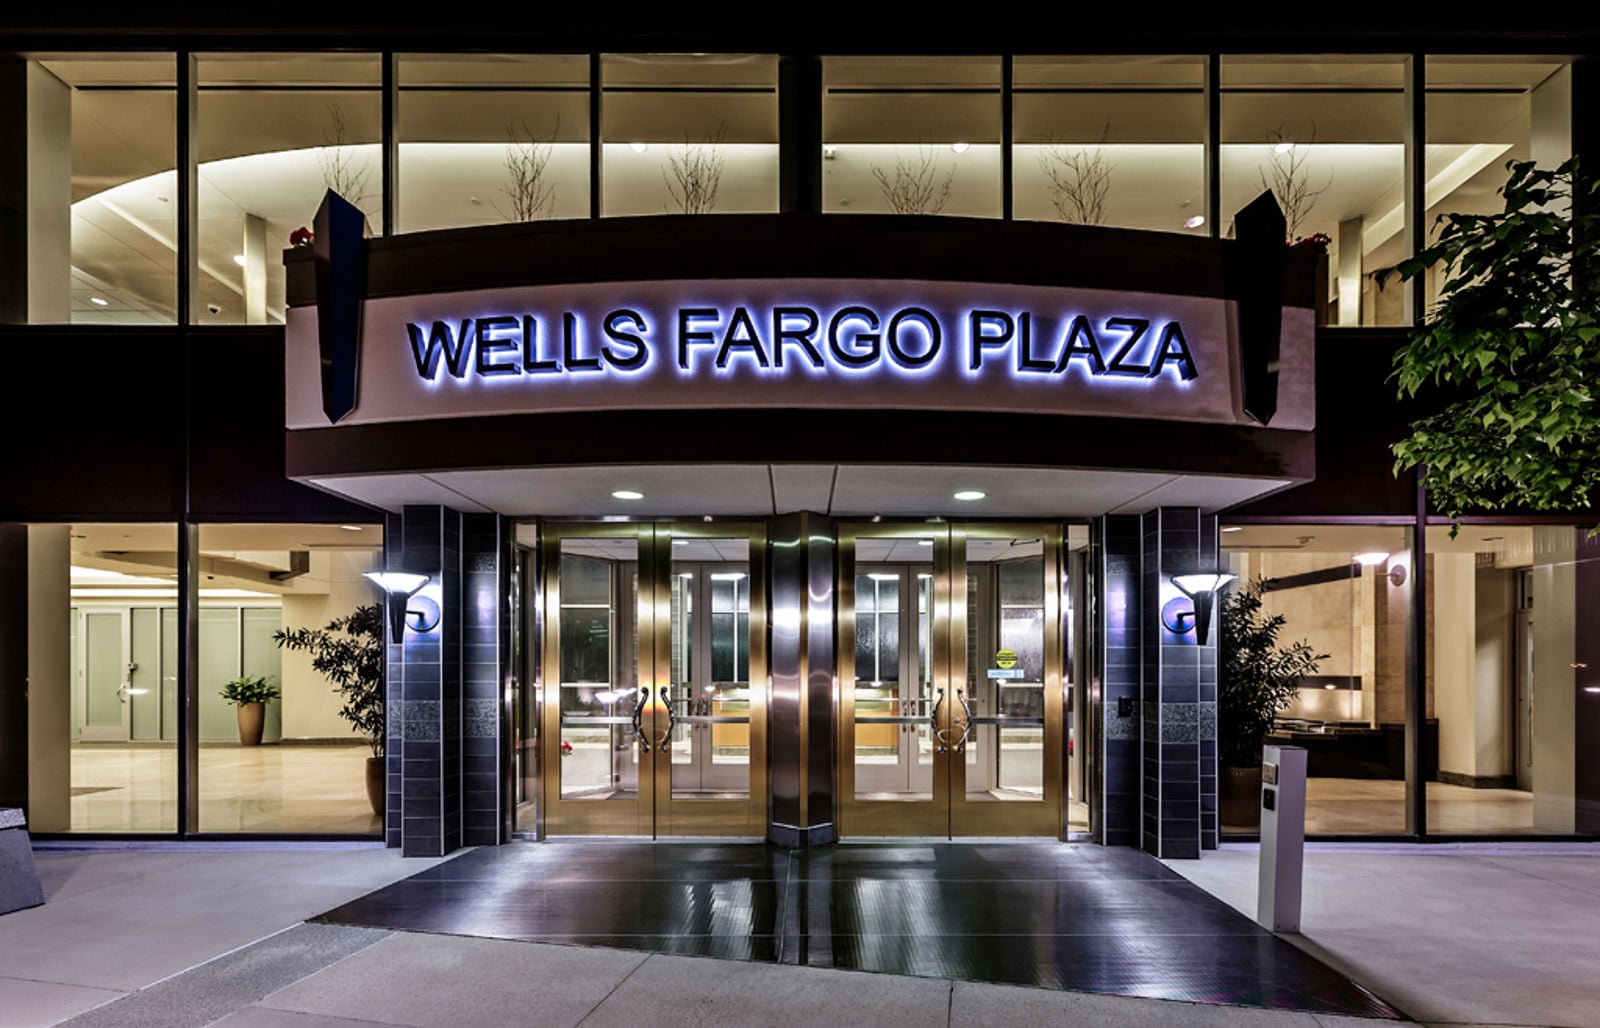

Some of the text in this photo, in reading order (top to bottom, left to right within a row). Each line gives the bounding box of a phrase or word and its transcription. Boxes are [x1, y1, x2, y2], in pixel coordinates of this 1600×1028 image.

[406, 306, 1199, 381] WELLS FARGO PLAZA
